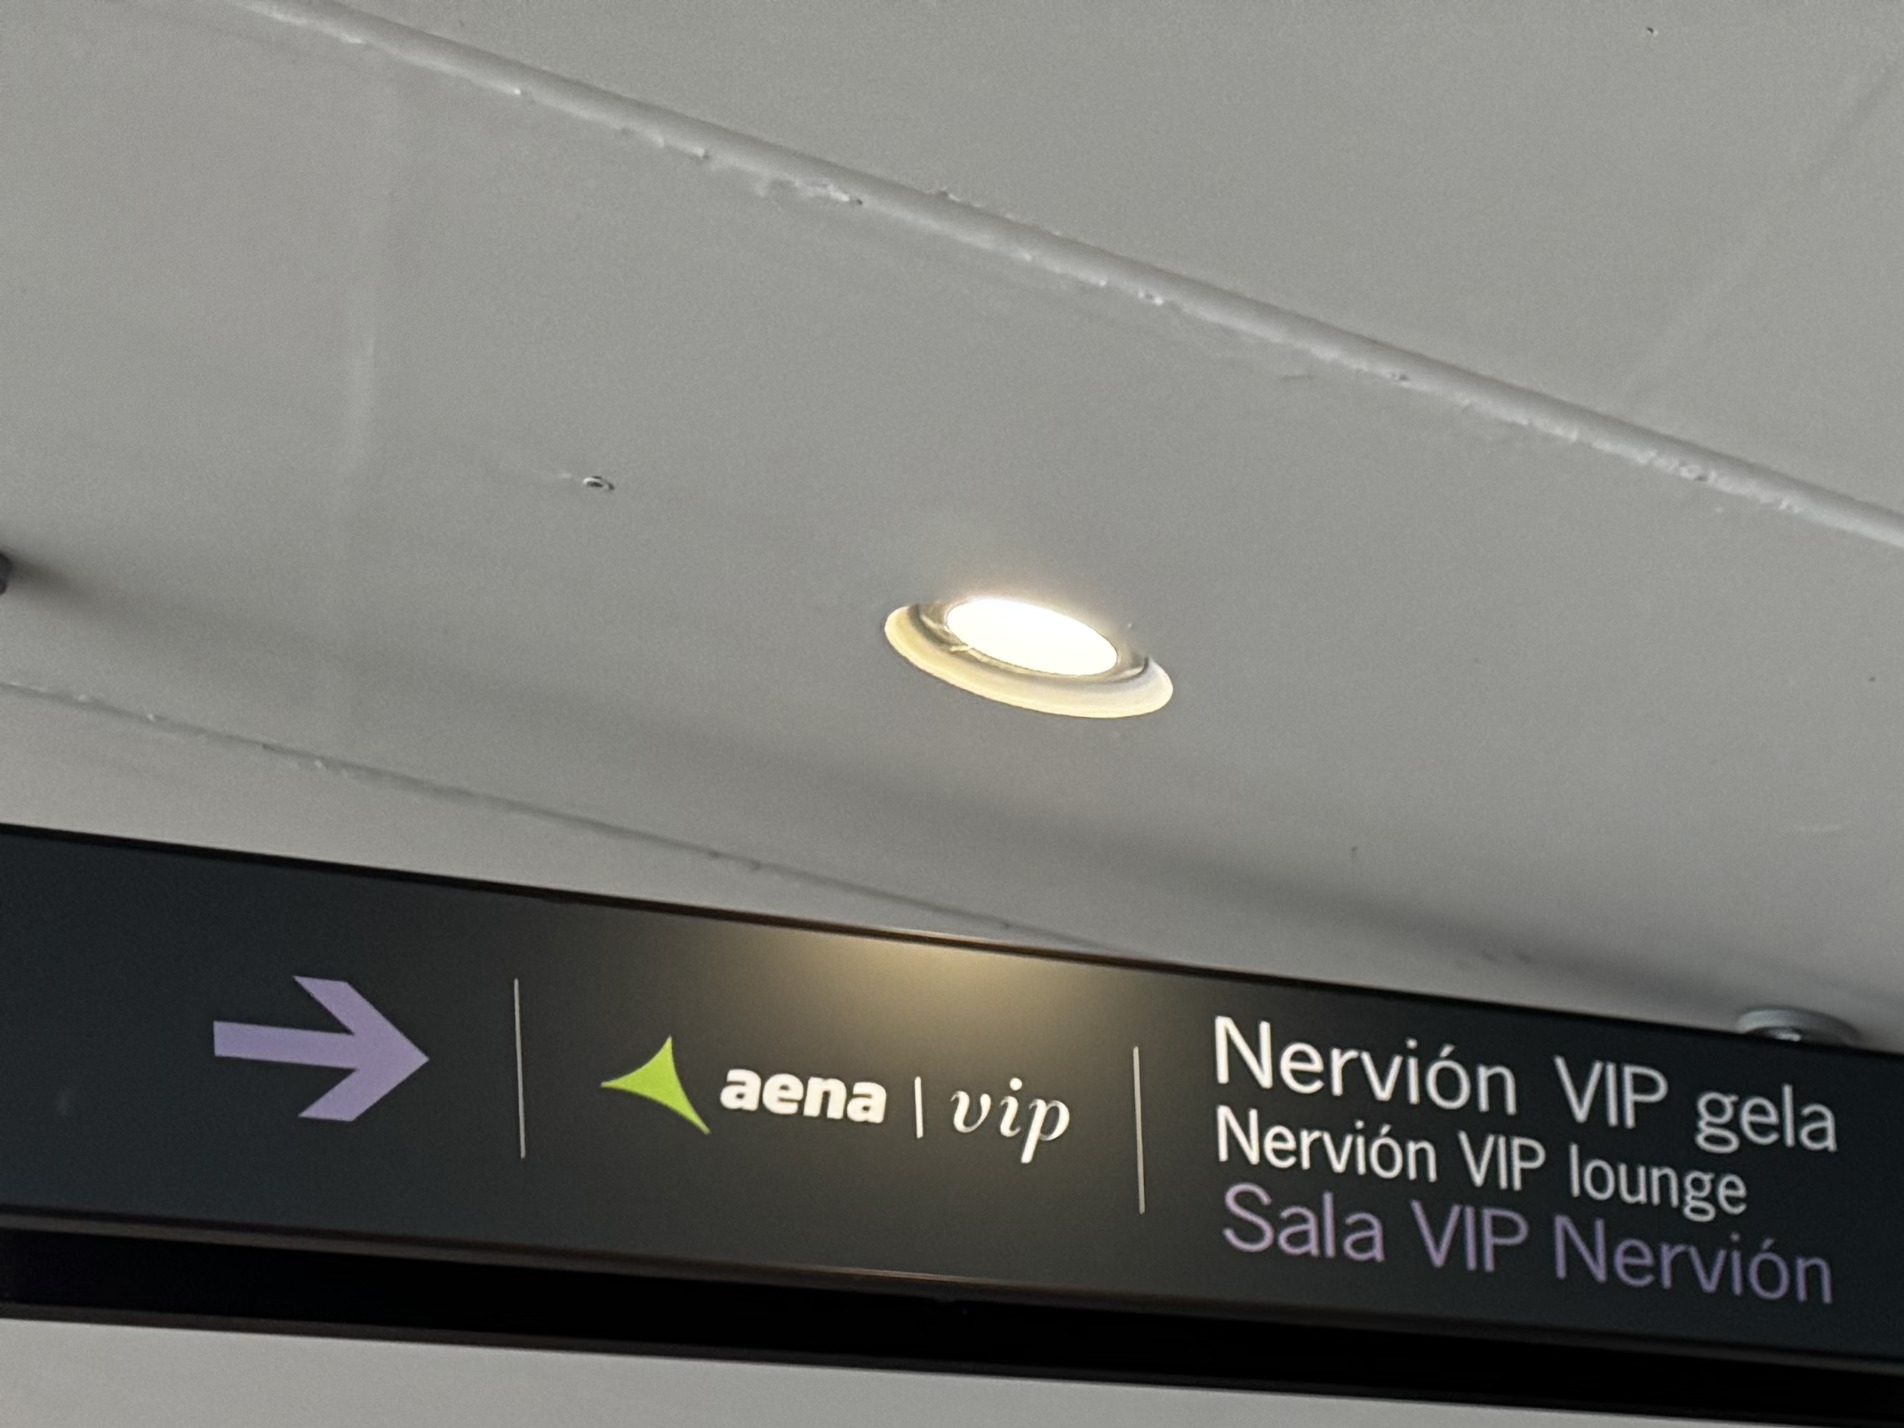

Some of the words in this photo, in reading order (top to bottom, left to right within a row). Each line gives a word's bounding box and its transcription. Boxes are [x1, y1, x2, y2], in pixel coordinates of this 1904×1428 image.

[720, 1068, 887, 1124] aena
[951, 1077, 1070, 1164] vip
[1214, 1015, 1516, 1118] Nervión
[1554, 1056, 1668, 1129] VIP
[1695, 1084, 1837, 1154] gela
[1216, 1105, 1438, 1182] Nervión
[1458, 1130, 1546, 1191] VIP
[1569, 1141, 1749, 1222] lounge
[1223, 1183, 1386, 1261] Sala
[1411, 1199, 1528, 1272] VIP
[1554, 1214, 1831, 1304] Nervión
